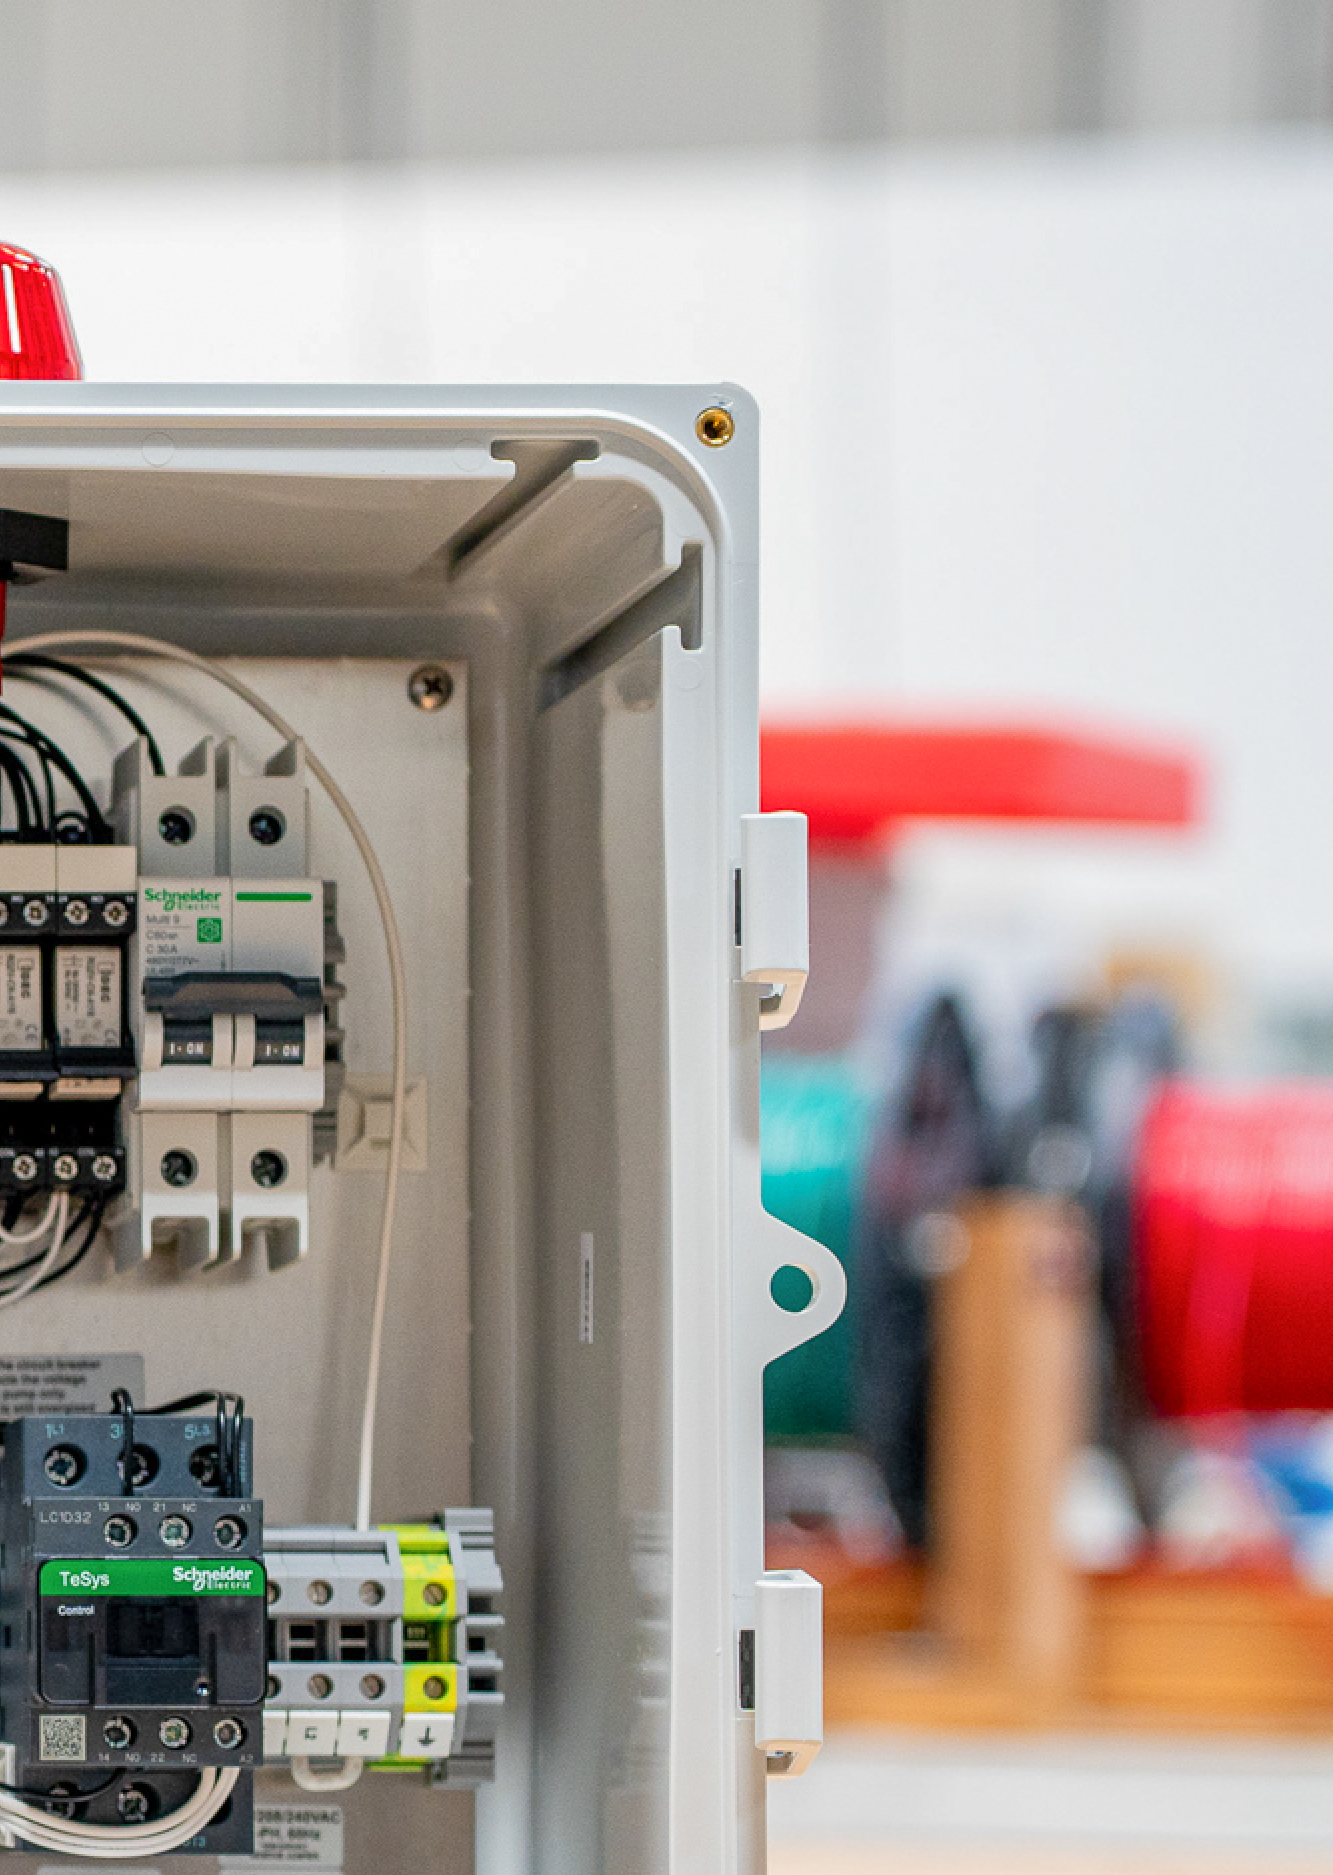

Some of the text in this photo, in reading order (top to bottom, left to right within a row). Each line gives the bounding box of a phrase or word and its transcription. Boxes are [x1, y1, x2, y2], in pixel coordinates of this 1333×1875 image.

[144, 887, 222, 912] Schneider
[39, 1511, 92, 1525] LC1D32
[58, 1570, 110, 1591] TeSys
[171, 1565, 254, 1592] Schneider
[57, 1604, 95, 1617] Control
